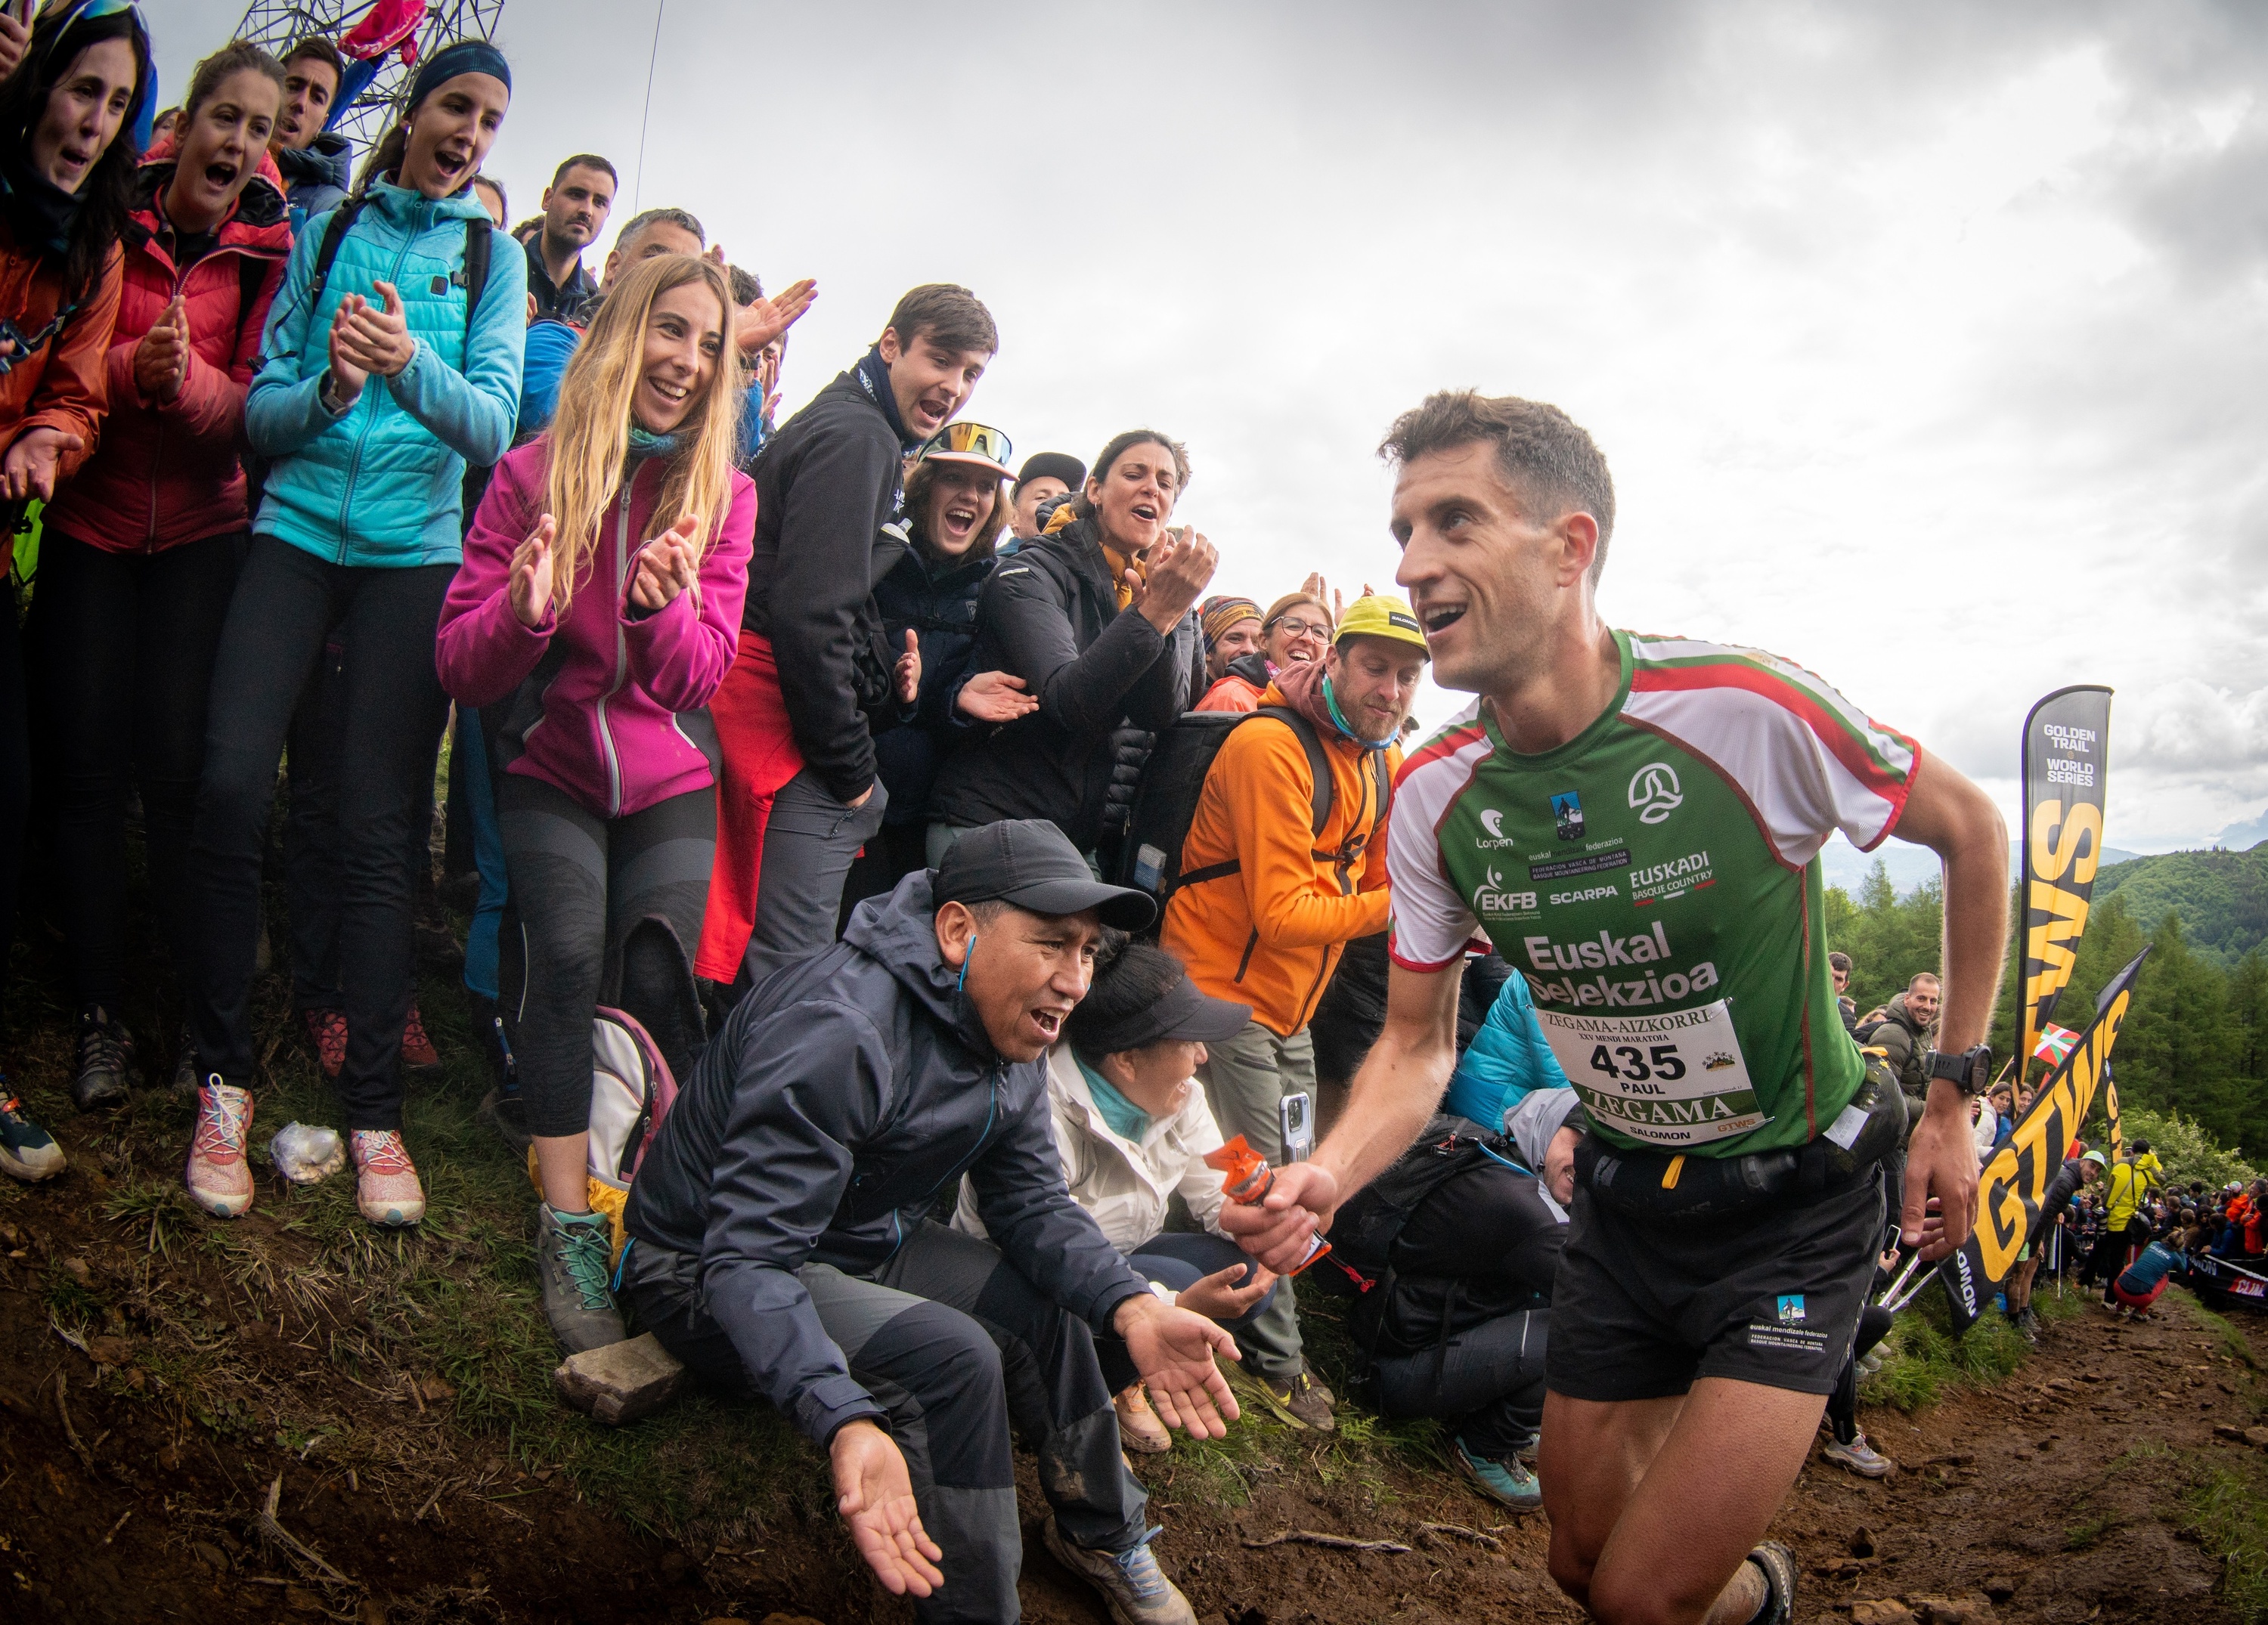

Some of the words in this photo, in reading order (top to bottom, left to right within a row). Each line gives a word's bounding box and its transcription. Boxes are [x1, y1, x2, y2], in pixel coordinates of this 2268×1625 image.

[1391, 615, 1418, 627] SALOMON
[2043, 724, 2096, 742] GOLDEN
[2051, 736, 2090, 753] TRAIL
[2046, 758, 2094, 775] WORLD
[2047, 770, 2093, 787] SERIES
[1476, 837, 1514, 850] Lorpen
[1532, 863, 1566, 873] FEDERACION
[1568, 860, 1588, 868] VASCA
[1532, 871, 1554, 880] BASQUE
[1554, 865, 1597, 877] MOUNTAINEERING
[1597, 858, 1628, 870] FEDERATION
[1629, 850, 1709, 889] EUSKADI
[1632, 884, 1665, 900] BASQUE
[1666, 869, 1713, 891] COUNTRY
[1482, 892, 1537, 911] EKFB
[1549, 885, 1619, 905] SCARPA
[1523, 920, 1672, 970] Euskal
[2020, 799, 2102, 1085] TWS
[1523, 961, 1719, 1007] Selekzioa
[1545, 1008, 1712, 1034] ZEGAMA-AIZKORRI
[1578, 1032, 1594, 1042] XXV
[1595, 1035, 1622, 1043] MENDI
[1622, 1033, 1670, 1043] MARATOIA
[1590, 1044, 1687, 1082] 435
[1619, 1082, 1665, 1095] PAUL
[1587, 1088, 1737, 1124] ZEGAMA
[1629, 1126, 1691, 1140] SALOMON
[1717, 1118, 1756, 1132] GTWS
[1956, 1249, 1976, 1317] OMON
[1772, 1326, 1804, 1336] mendizale
[1805, 1330, 1828, 1339] federazioa
[1768, 1341, 1803, 1349] MOUNTAINEERING
